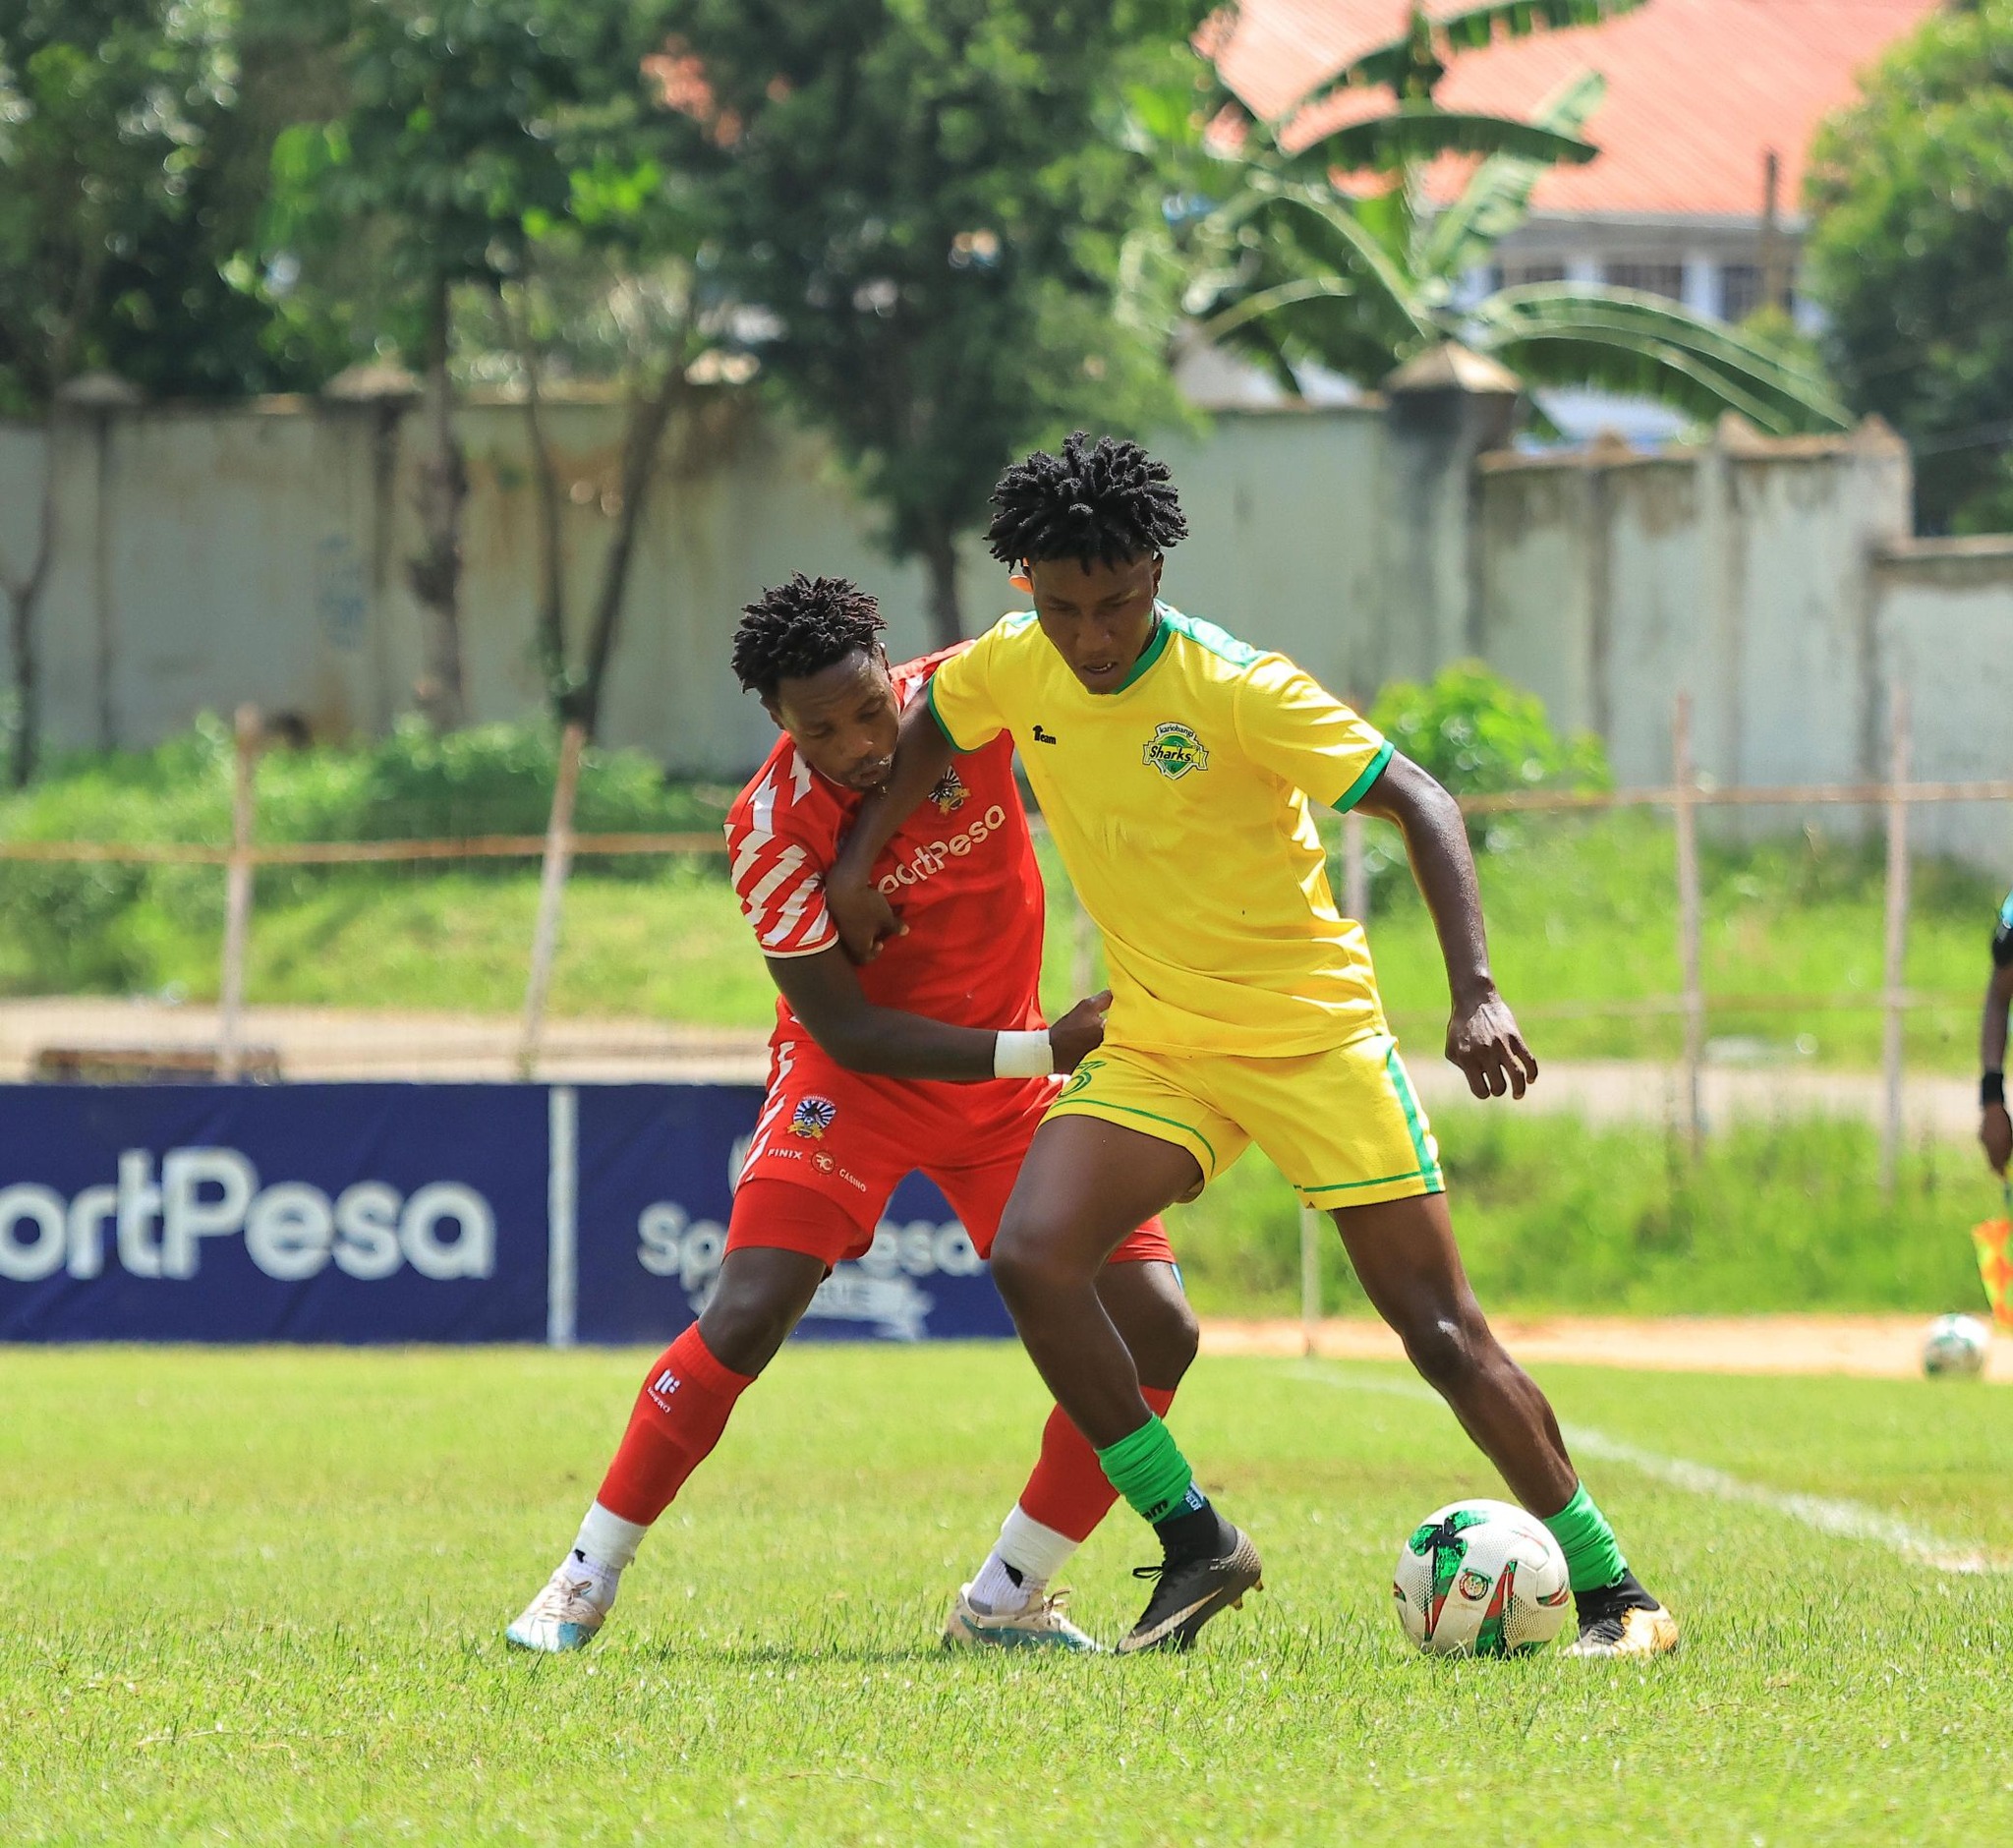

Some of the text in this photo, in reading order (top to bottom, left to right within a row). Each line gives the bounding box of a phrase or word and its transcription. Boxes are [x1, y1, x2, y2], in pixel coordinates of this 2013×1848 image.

[1149, 745, 1192, 762] Sharks
[768, 1148, 803, 1160] FINIX
[839, 1169, 866, 1192] CASINO
